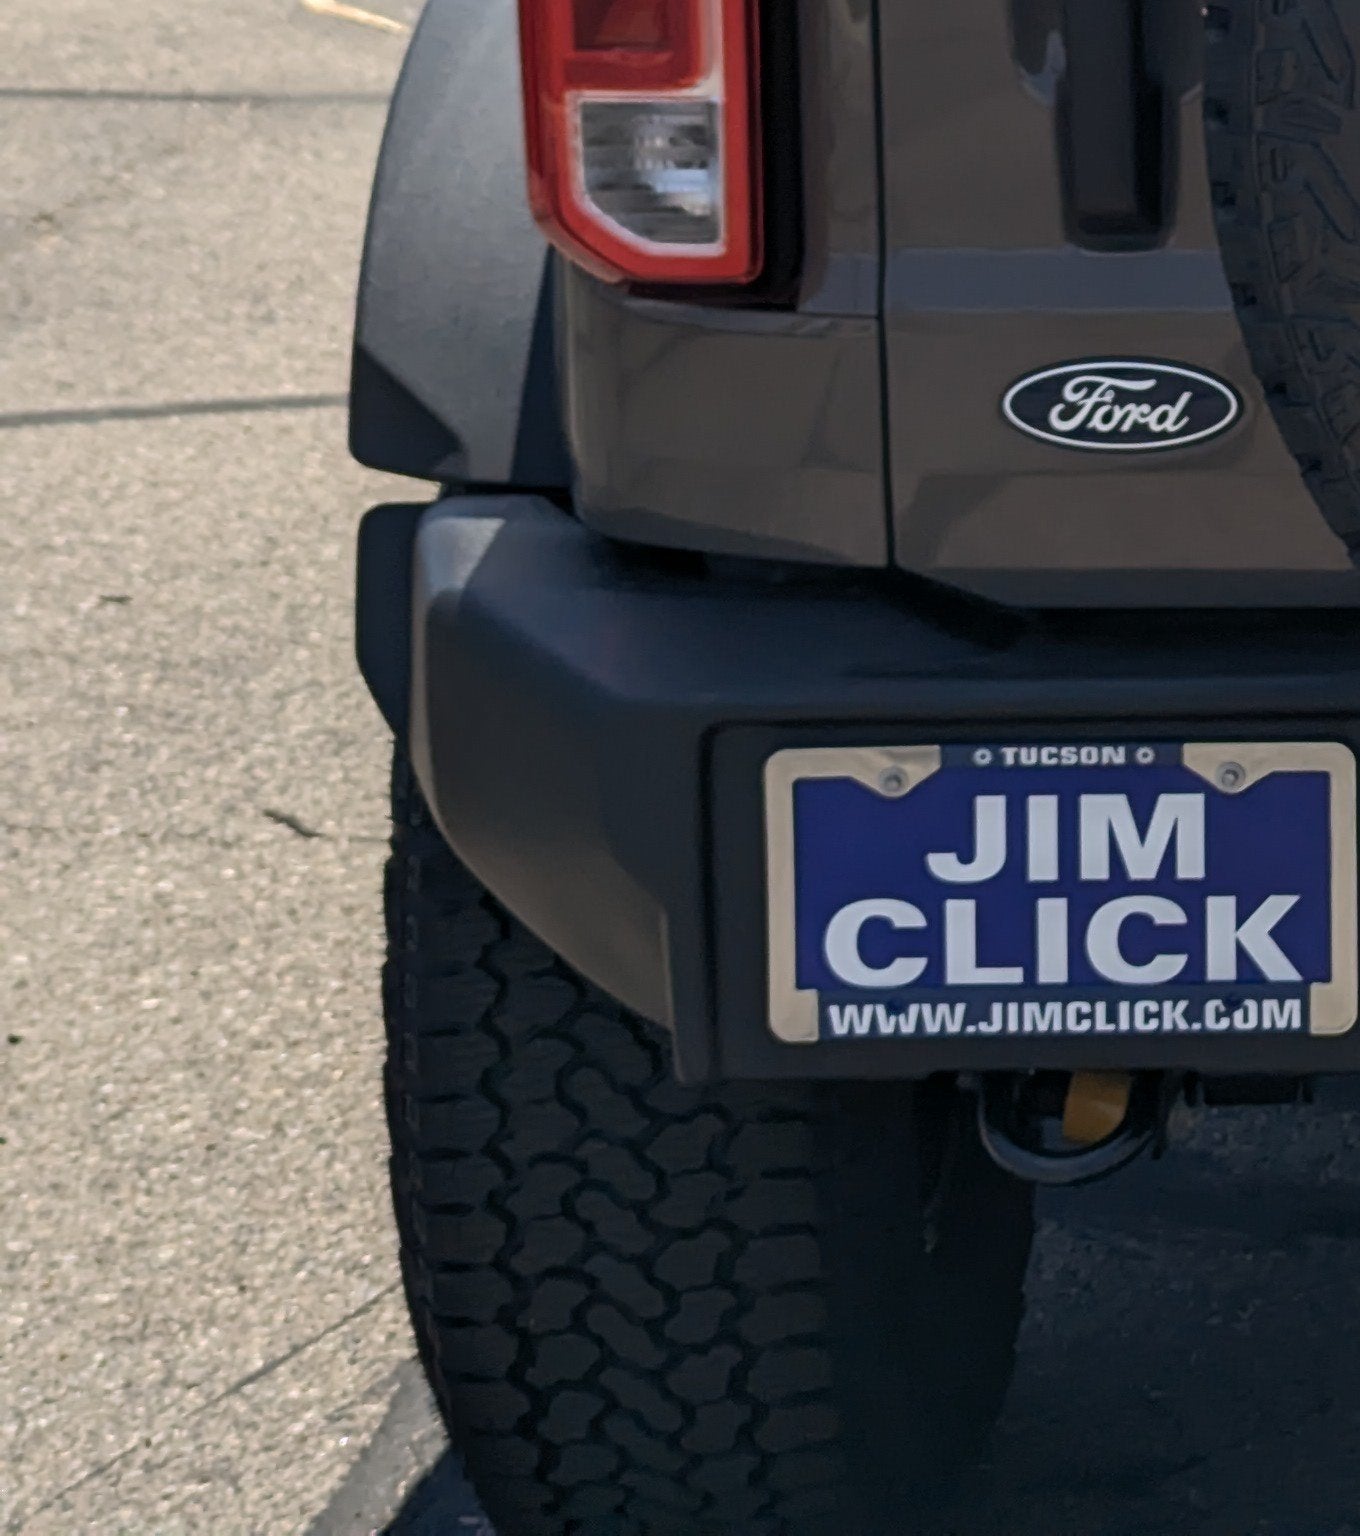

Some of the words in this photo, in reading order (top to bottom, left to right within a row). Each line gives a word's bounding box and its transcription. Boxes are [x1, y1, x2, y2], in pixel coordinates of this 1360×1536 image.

[1048, 375, 1193, 433] Ford
[1001, 747, 1126, 765] TUCSON
[926, 793, 1206, 883] JIM
[824, 894, 1303, 988] CLICK
[828, 998, 1301, 1036] WWW.JIMCLICK.COM
